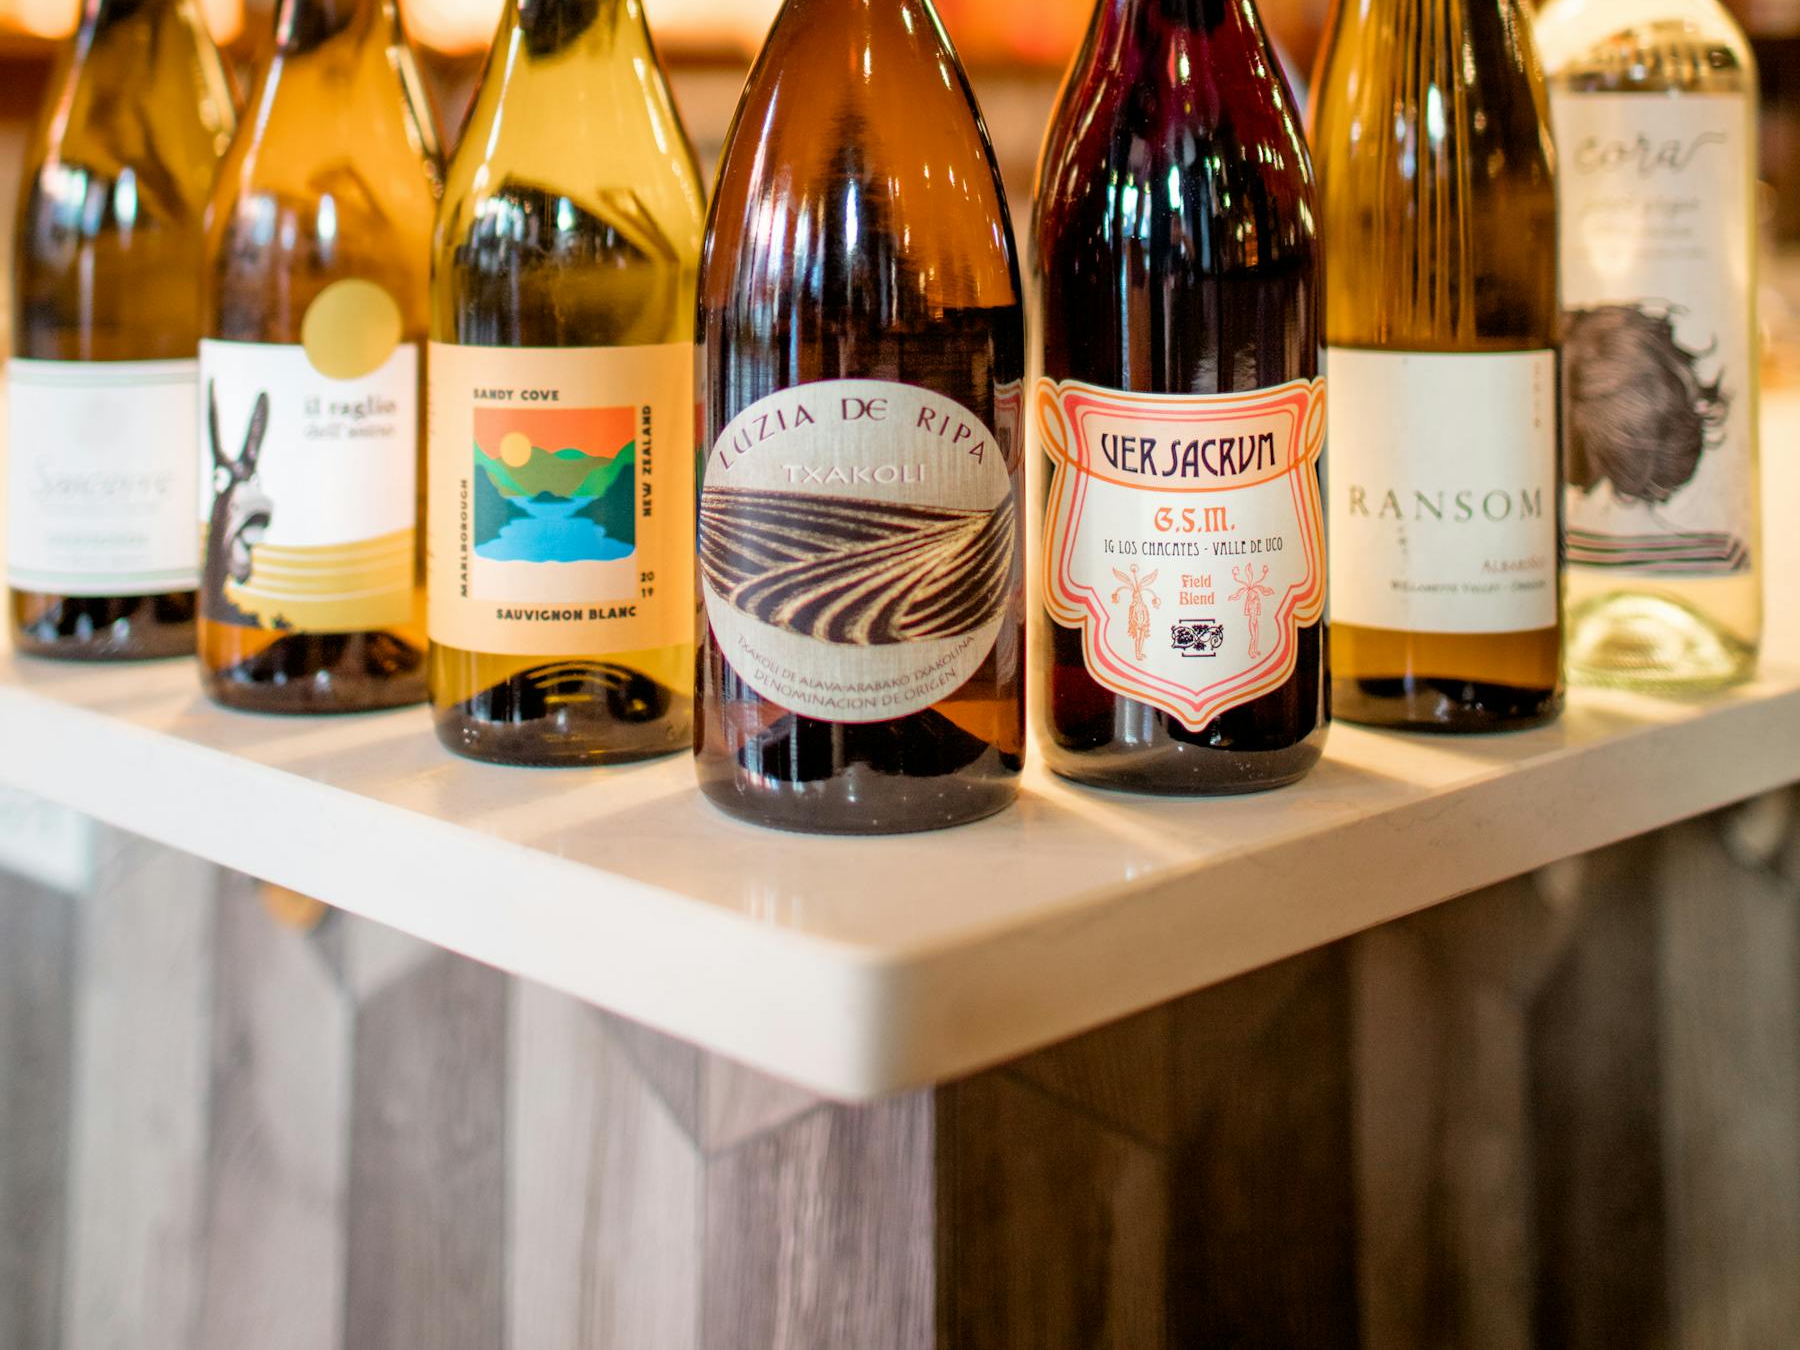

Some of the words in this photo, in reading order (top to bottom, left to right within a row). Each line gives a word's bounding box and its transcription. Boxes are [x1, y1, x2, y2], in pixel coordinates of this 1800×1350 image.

[473, 389, 514, 401] SANDY
[521, 390, 560, 401] COVE
[642, 405, 652, 475] ZEALAND
[719, 404, 815, 470] LUZIA
[841, 398, 888, 421] DE
[916, 406, 986, 465] RIPA
[782, 464, 926, 484] TXAKOLI
[642, 483, 652, 518] NEW
[1349, 485, 1543, 523] RANSOM
[460, 480, 468, 598] MARLBOROUGH
[1119, 540, 1138, 555] LOS
[1142, 541, 1200, 556] CHACAYES
[1212, 539, 1246, 556] VALLE
[1250, 538, 1262, 554] DE
[1265, 537, 1283, 552] UCO
[1181, 574, 1212, 588] Field
[497, 609, 583, 621] SAUVIGNON
[589, 606, 636, 620] BLANC
[1179, 592, 1215, 606] Blend
[738, 634, 779, 676] TXAKOLI
[782, 667, 796, 682] DE
[913, 636, 975, 680] TXAKOLINA
[754, 668, 876, 709] DENOMINACION
[881, 693, 900, 707] DE
[904, 668, 957, 701] ORIGEN
